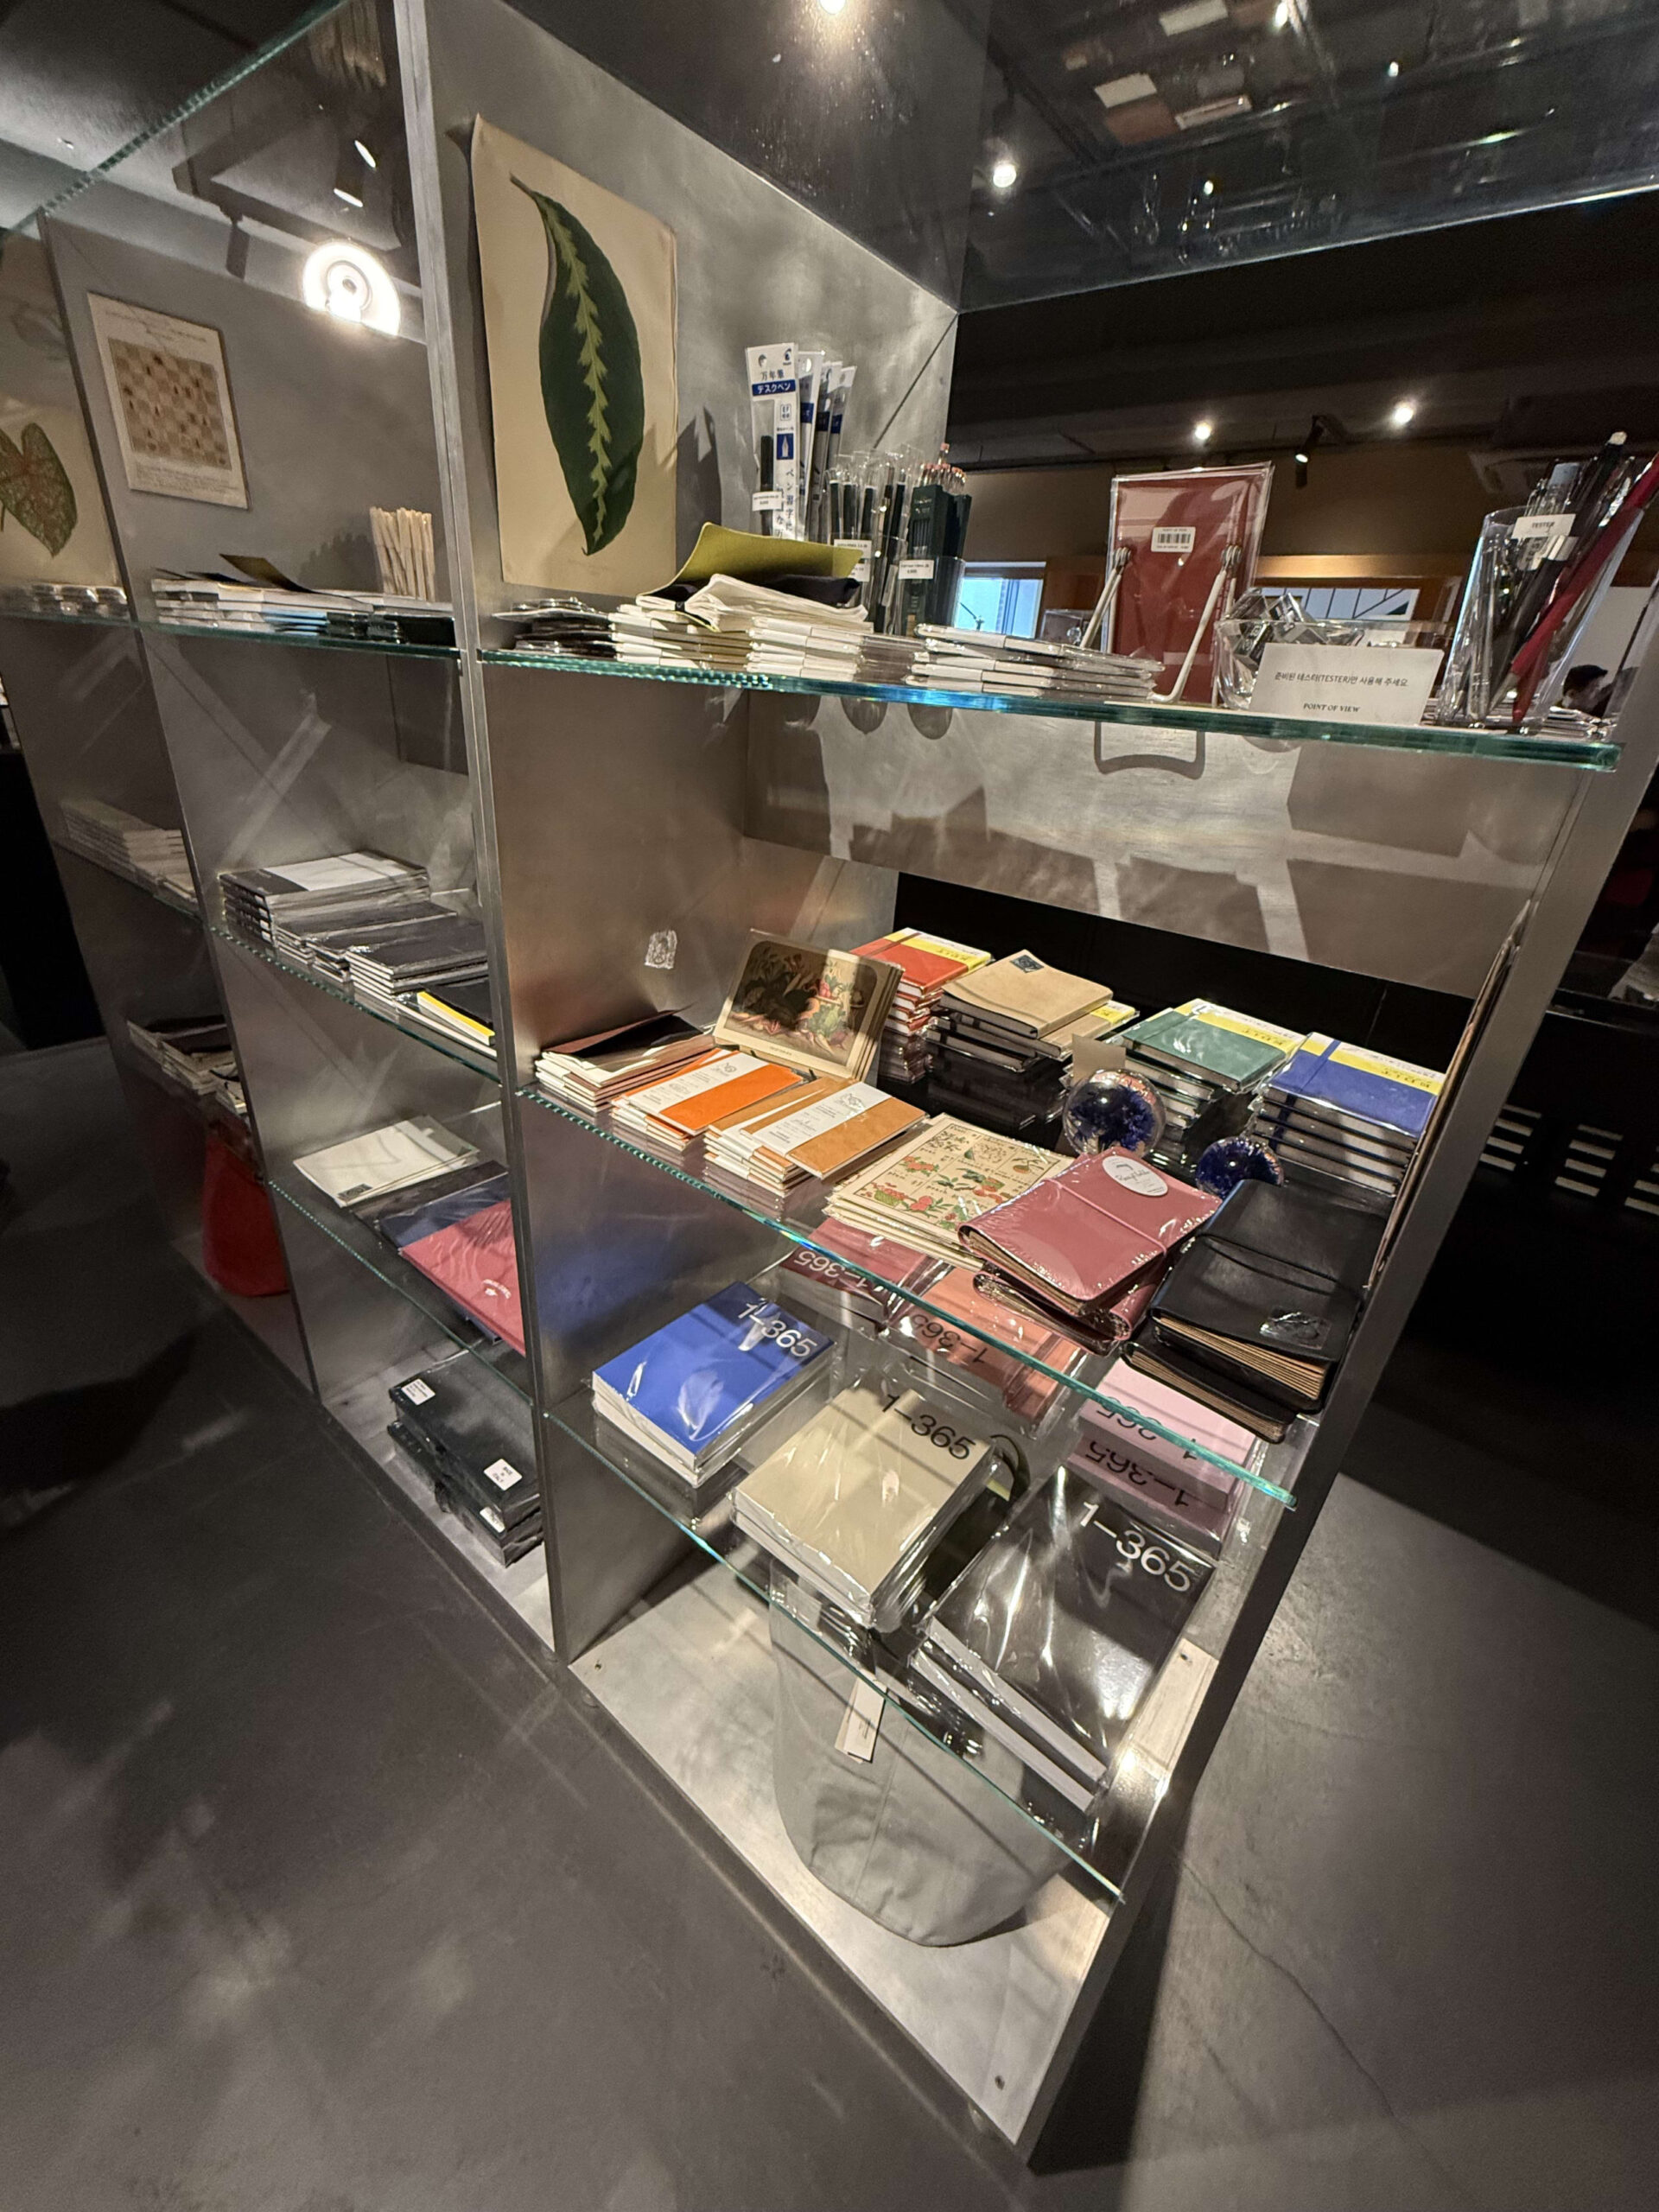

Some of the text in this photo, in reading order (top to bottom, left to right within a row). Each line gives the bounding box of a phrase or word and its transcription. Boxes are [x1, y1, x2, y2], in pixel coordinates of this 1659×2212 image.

[758, 383, 791, 394] デスクペン
[738, 1302, 818, 1357] 1-365
[882, 1393, 977, 1460] 1-365
[1080, 1501, 1196, 1592] 1-365
